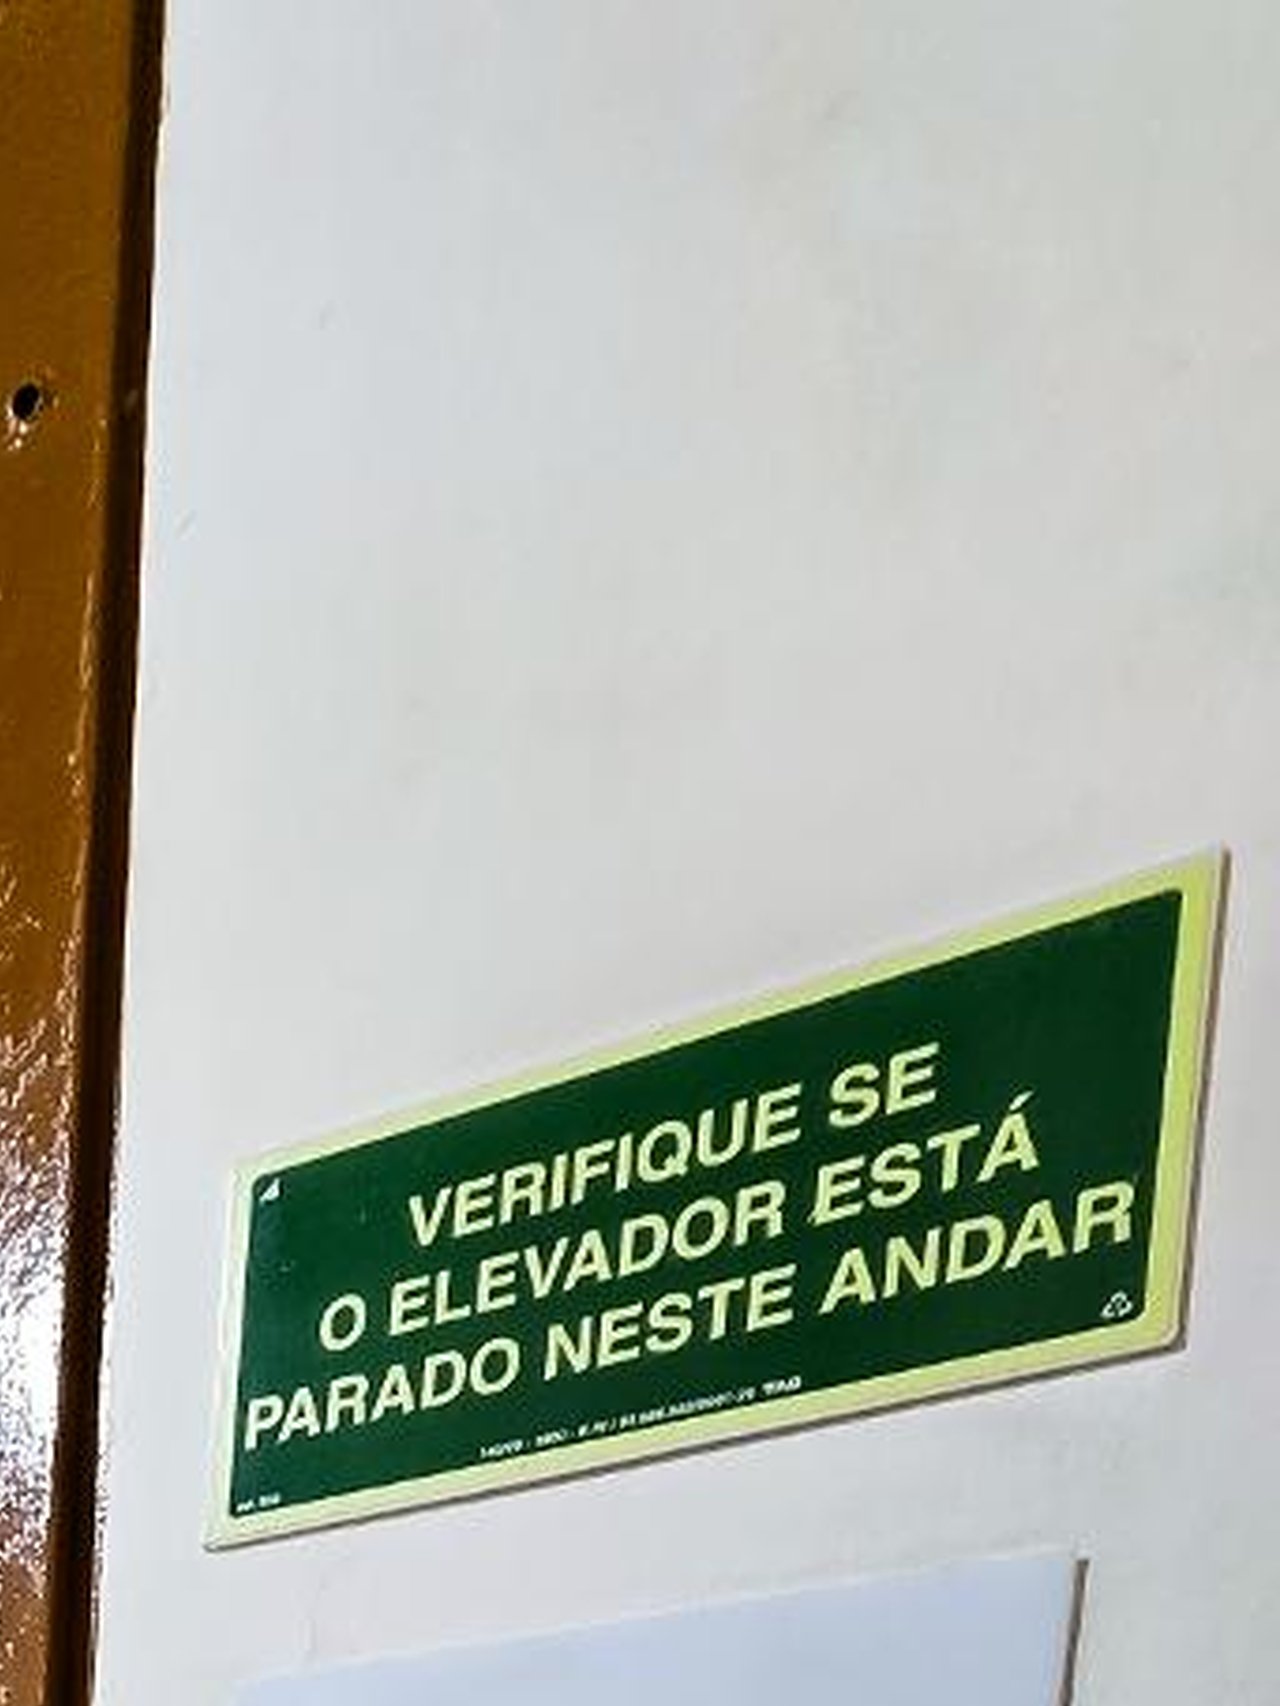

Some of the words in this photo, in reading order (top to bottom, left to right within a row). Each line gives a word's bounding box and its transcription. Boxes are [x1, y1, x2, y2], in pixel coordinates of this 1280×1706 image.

[318, 1293, 368, 1352] O
[387, 1180, 786, 1336] ELEVADOR
[807, 1091, 1040, 1227] ESTÁ
[407, 1083, 802, 1248] VERIFIQUE
[828, 1042, 940, 1128] SE
[243, 1337, 521, 1453] PARADO
[542, 1263, 797, 1382] NESTE
[817, 1181, 1136, 1314] ANDAR
